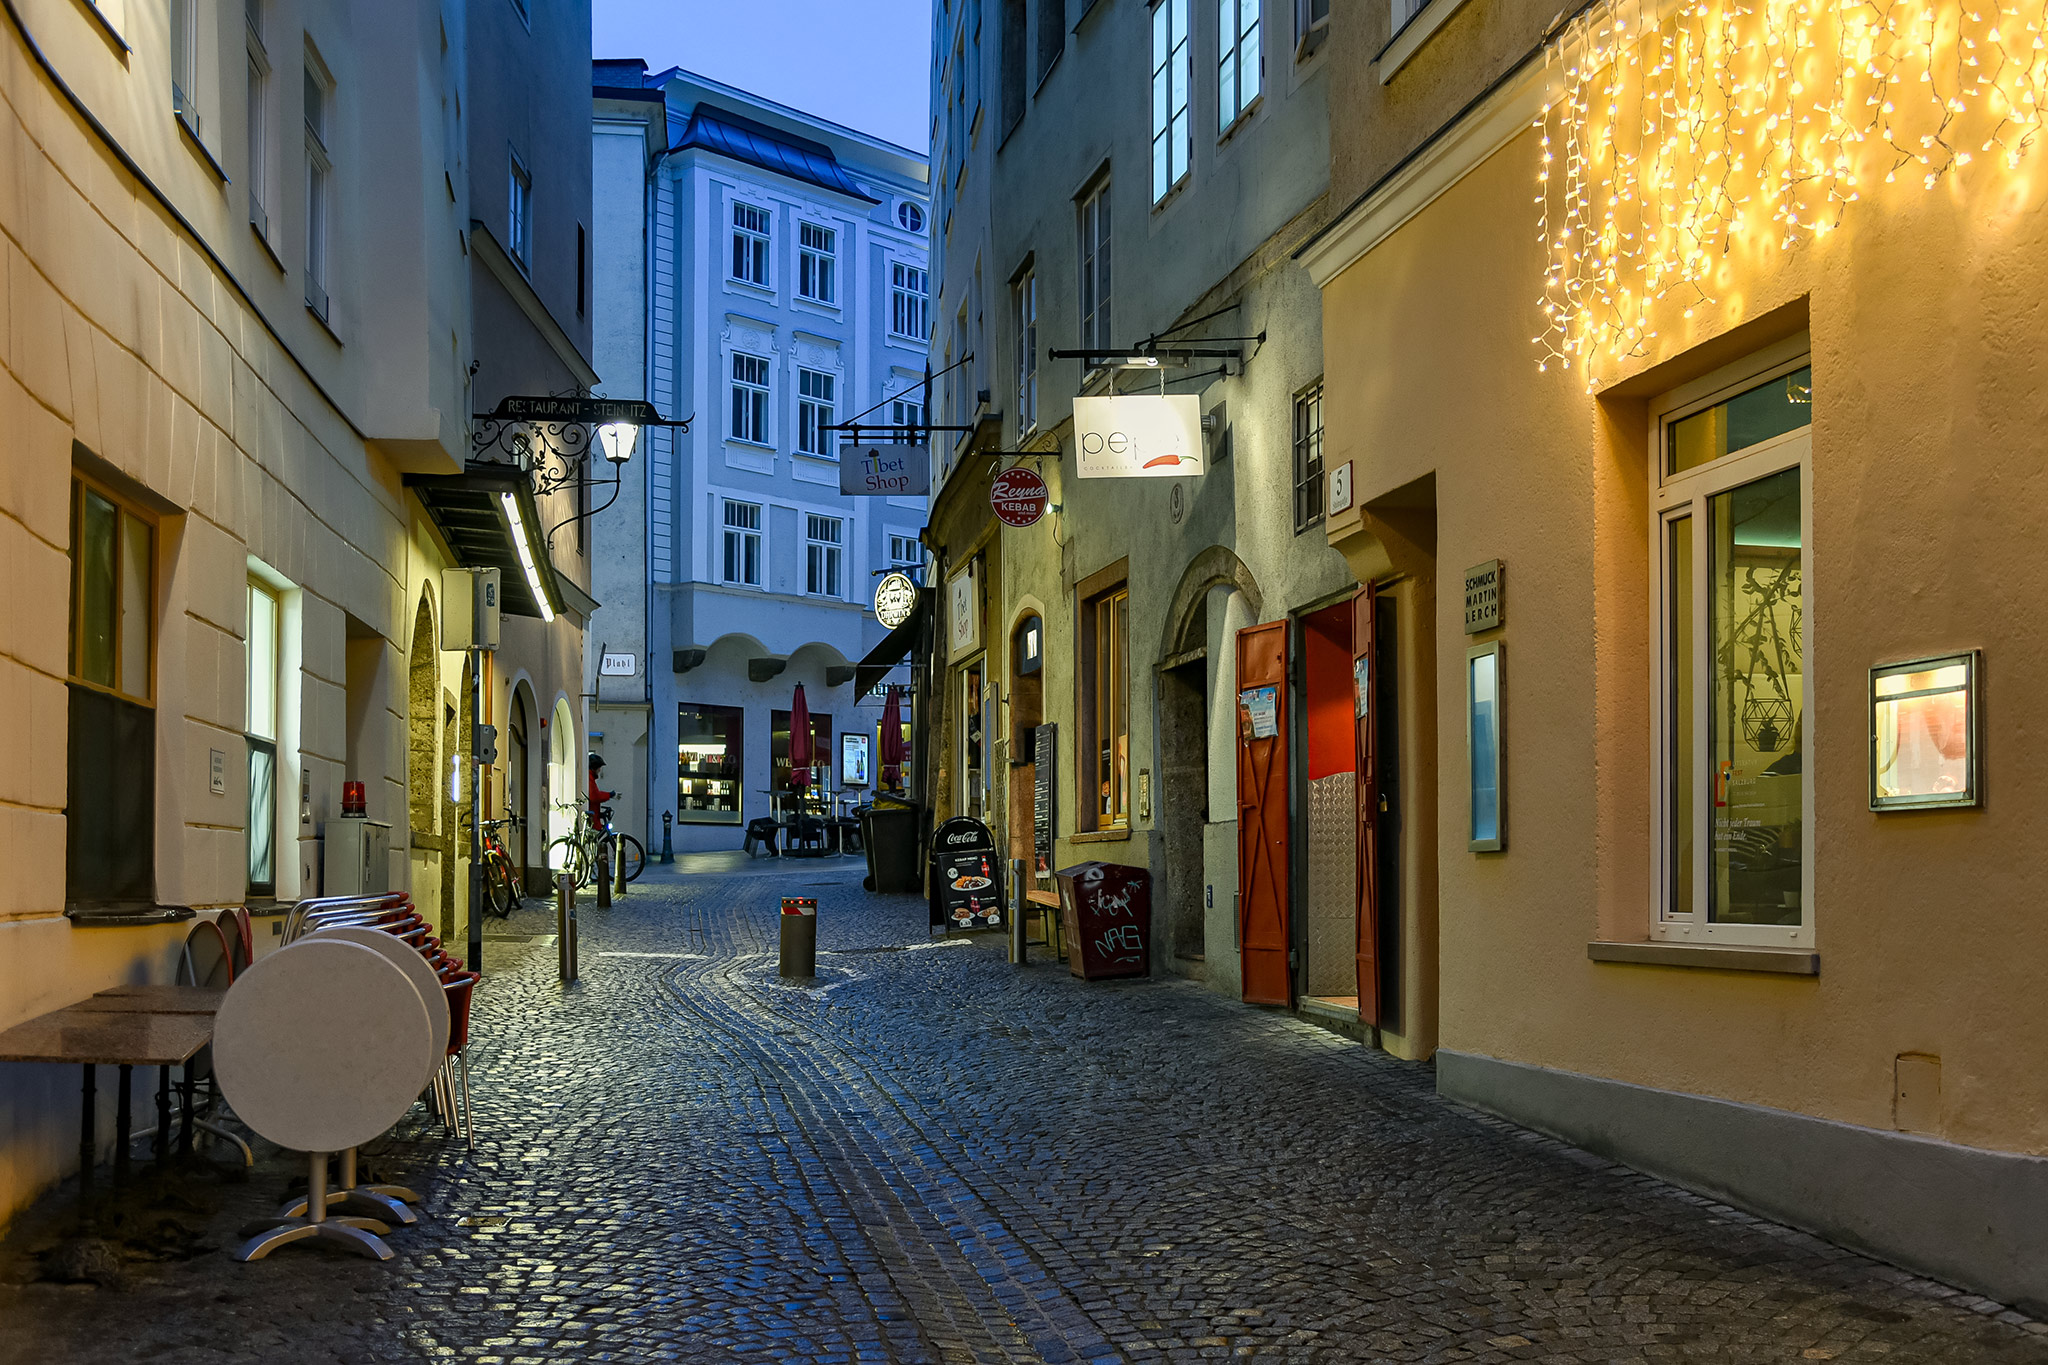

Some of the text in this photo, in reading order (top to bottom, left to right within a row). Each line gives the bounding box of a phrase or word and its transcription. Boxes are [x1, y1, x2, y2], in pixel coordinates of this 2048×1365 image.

[861, 457, 904, 475] Tibet
[866, 475, 909, 491] Shop
[993, 482, 1046, 499] Reyna
[1336, 469, 1343, 497] 5
[1001, 502, 1036, 512] KEBAB
[1465, 570, 1496, 592] SCHMUCK
[1466, 587, 1497, 608] MARTIN
[1466, 603, 1497, 624] LERCH
